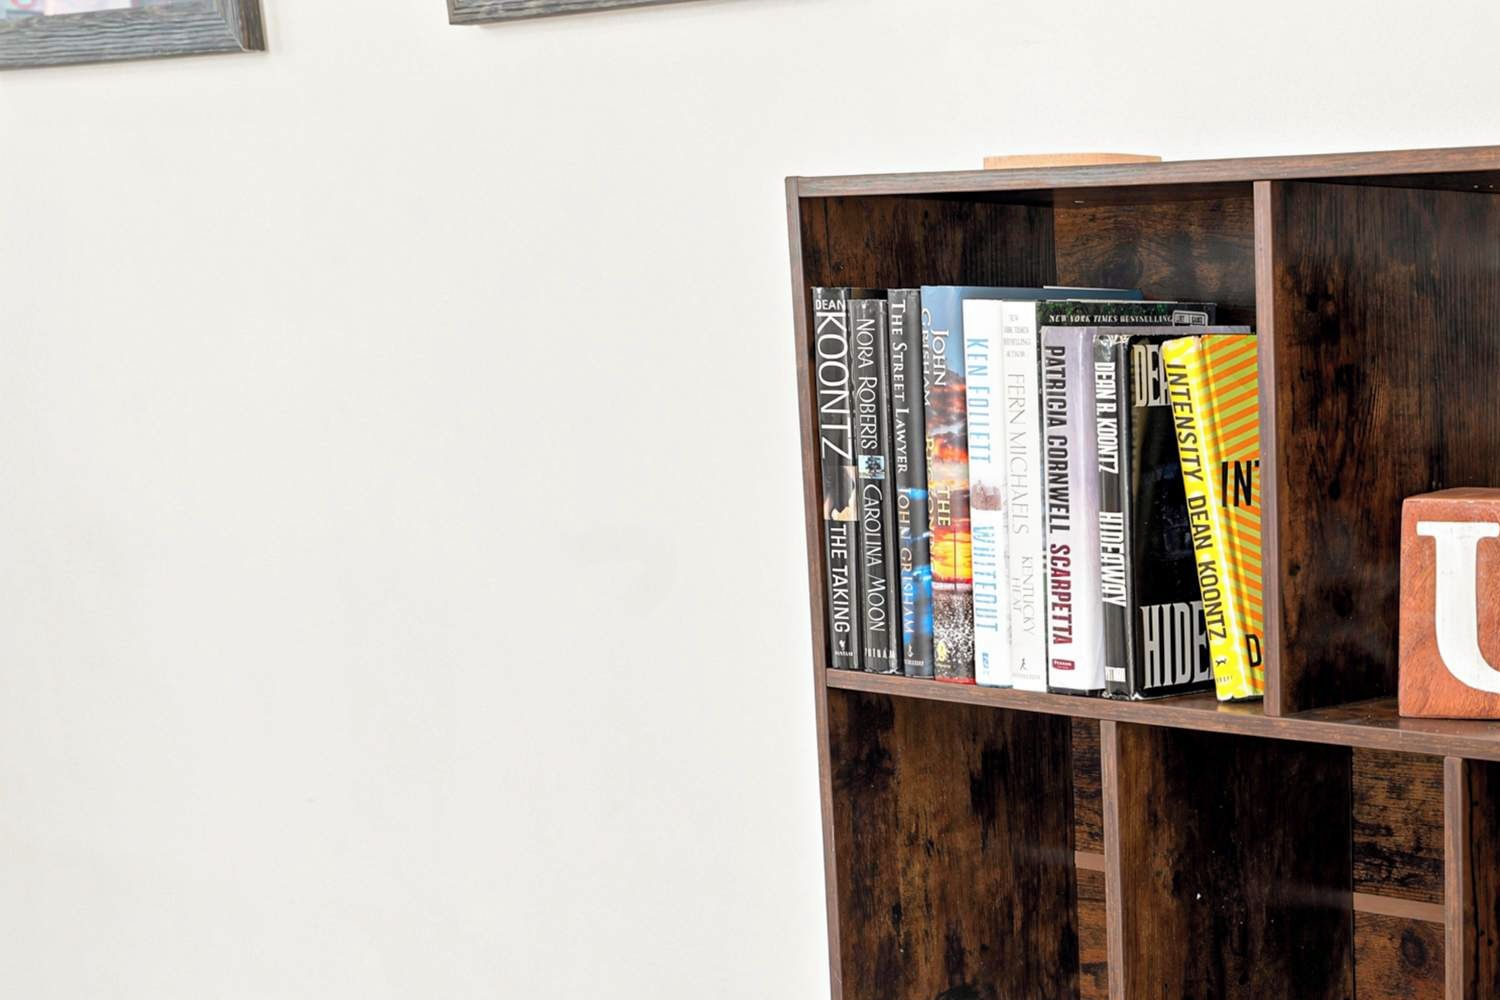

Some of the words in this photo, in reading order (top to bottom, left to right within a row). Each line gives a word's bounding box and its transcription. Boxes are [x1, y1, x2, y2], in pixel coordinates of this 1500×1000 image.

[815, 299, 845, 311] DEAN
[890, 299, 906, 336] THE
[1070, 315, 1090, 323] YORK
[1093, 315, 1118, 323] TIMES
[856, 318, 875, 368] NORA
[892, 341, 908, 402] STREET
[931, 328, 949, 386] JOHN
[966, 338, 989, 377] KEN
[815, 311, 853, 460] KOONTZ
[1007, 373, 1026, 425] FERN
[1044, 345, 1067, 428] PATRICIA
[1094, 361, 1117, 400] DEAN
[1131, 344, 1173, 408] DEA
[858, 376, 878, 449] ROBERTS
[894, 407, 910, 473] LAWYER
[967, 385, 991, 464] FOLLETT
[1166, 363, 1205, 481] INTENSITY
[1096, 417, 1119, 475] KOONTZ
[936, 487, 951, 527] THE
[1009, 431, 1030, 535] MICHAELS
[1047, 436, 1071, 534] CORNWELL
[1221, 460, 1260, 509] IN
[829, 523, 848, 560] THE
[862, 483, 884, 567] CAROLINA
[897, 487, 912, 545] JOHN
[1187, 495, 1213, 550] DEAN
[900, 547, 915, 634] GRISHAM
[972, 526, 999, 632] WHITEOUT
[1099, 511, 1127, 607] HIDEAWAY
[831, 565, 851, 634] TAKING
[866, 573, 887, 632] MOON
[1022, 556, 1036, 637] KENTUCKY
[1049, 543, 1074, 645] SCARPETTA
[1197, 561, 1227, 642] KOONTZ
[1140, 601, 1214, 689] HIDE
